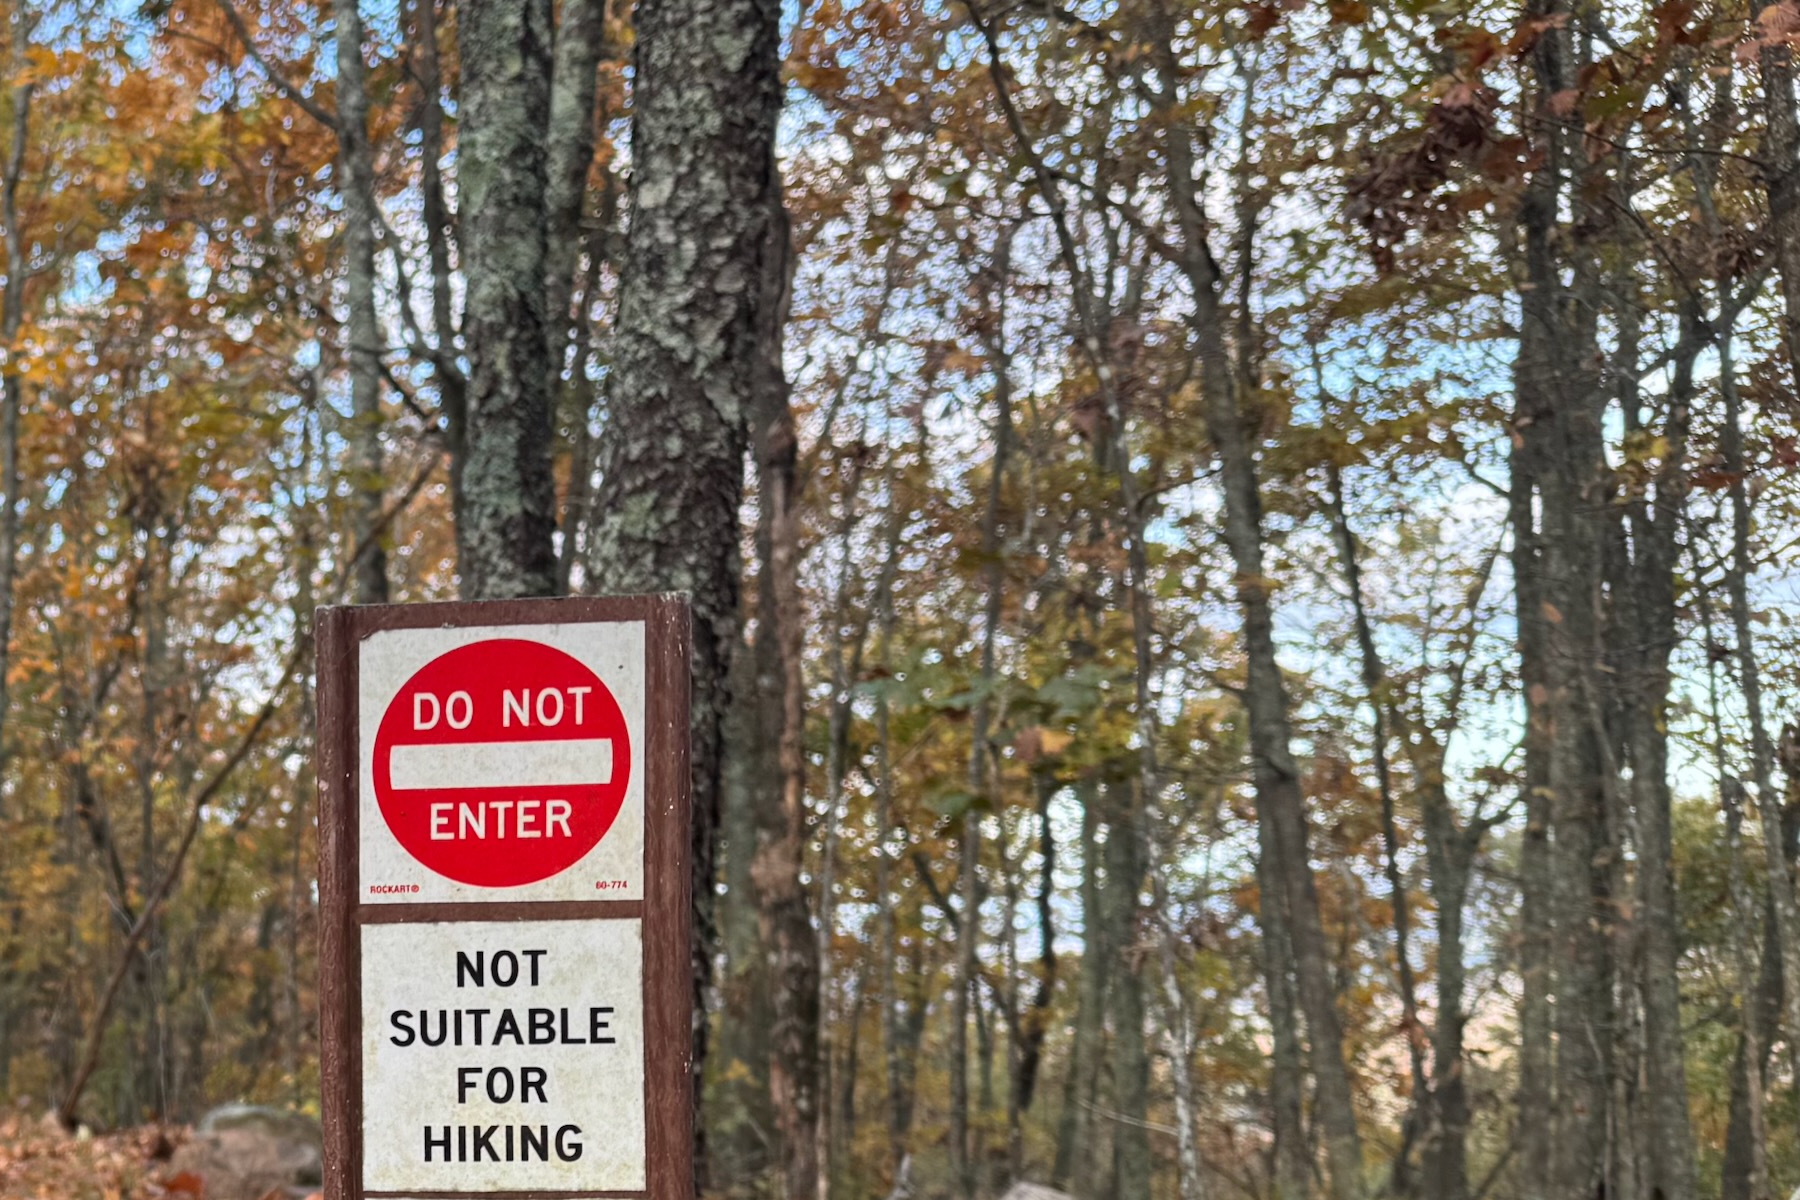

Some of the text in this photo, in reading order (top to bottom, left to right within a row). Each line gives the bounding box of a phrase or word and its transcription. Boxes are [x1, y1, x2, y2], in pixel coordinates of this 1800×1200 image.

[413, 686, 592, 731] DO NOT
[430, 799, 573, 840] ENTER
[456, 949, 548, 988] NOT
[389, 1006, 616, 1047] SUITABLE
[457, 1066, 548, 1104] FOR
[424, 1124, 584, 1162] HIKING
